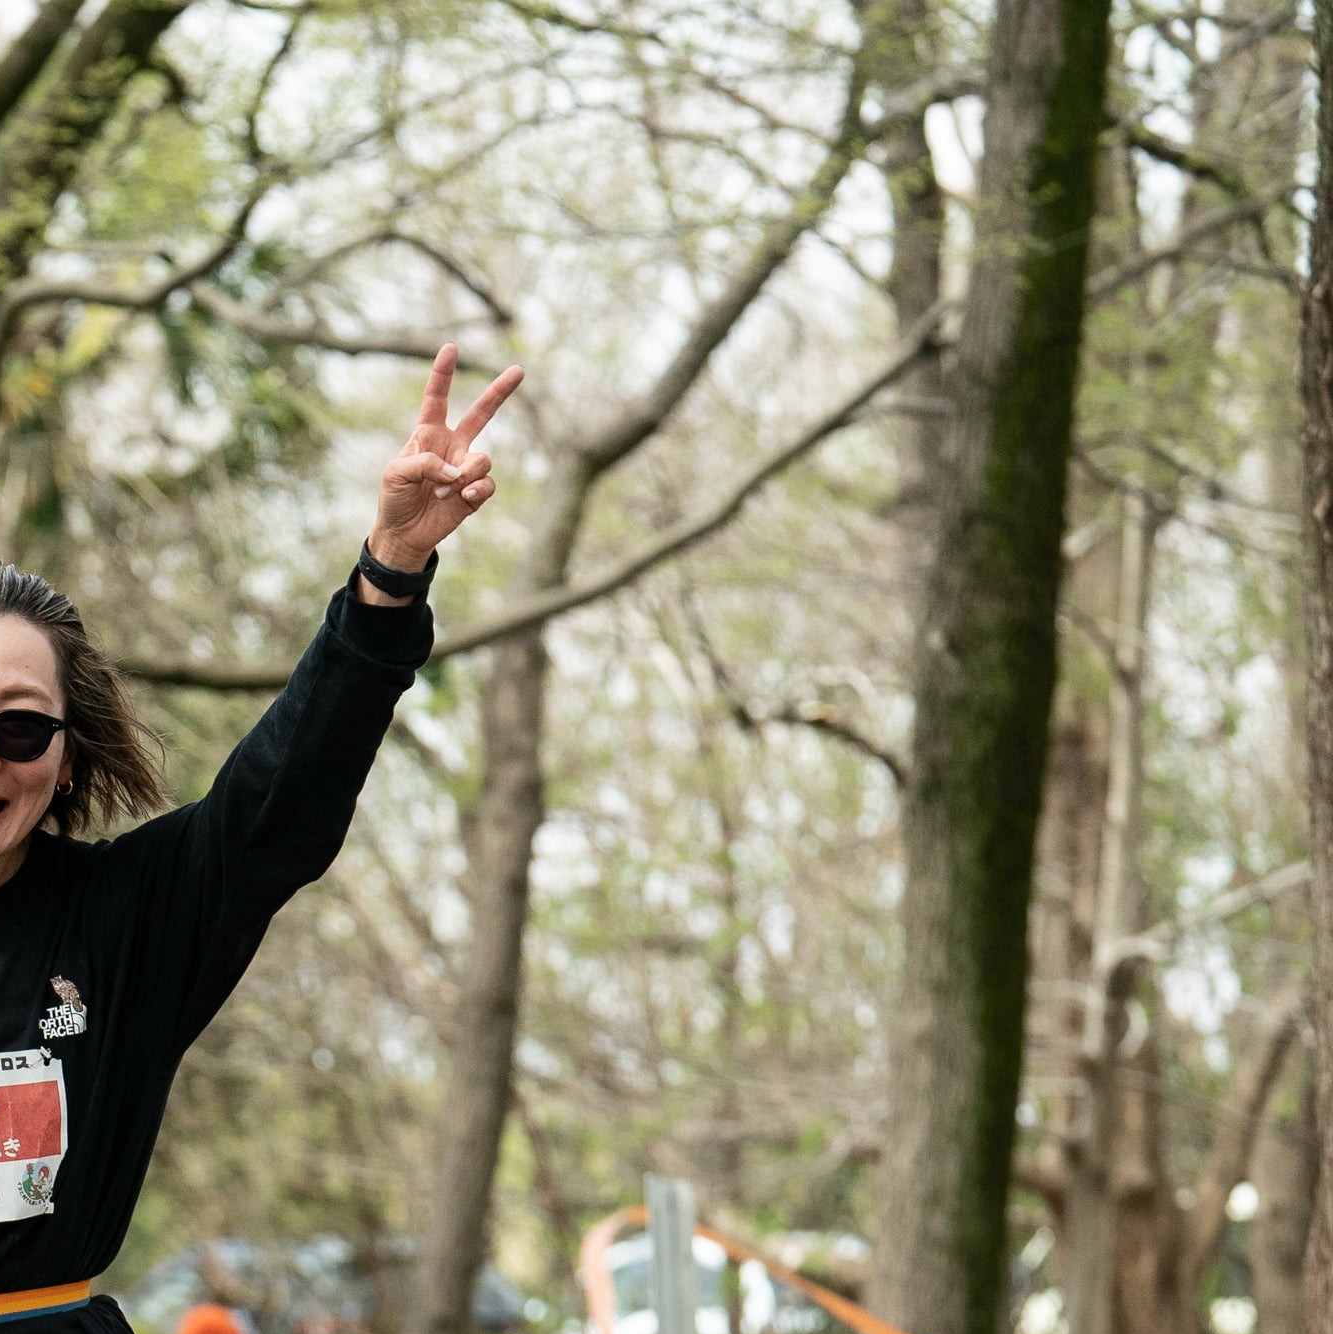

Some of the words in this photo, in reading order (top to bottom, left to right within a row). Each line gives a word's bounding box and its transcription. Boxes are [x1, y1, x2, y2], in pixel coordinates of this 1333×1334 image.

[47, 1004, 71, 1018] THE
[39, 1013, 73, 1029] ORTH
[43, 1025, 74, 1040] FACE
